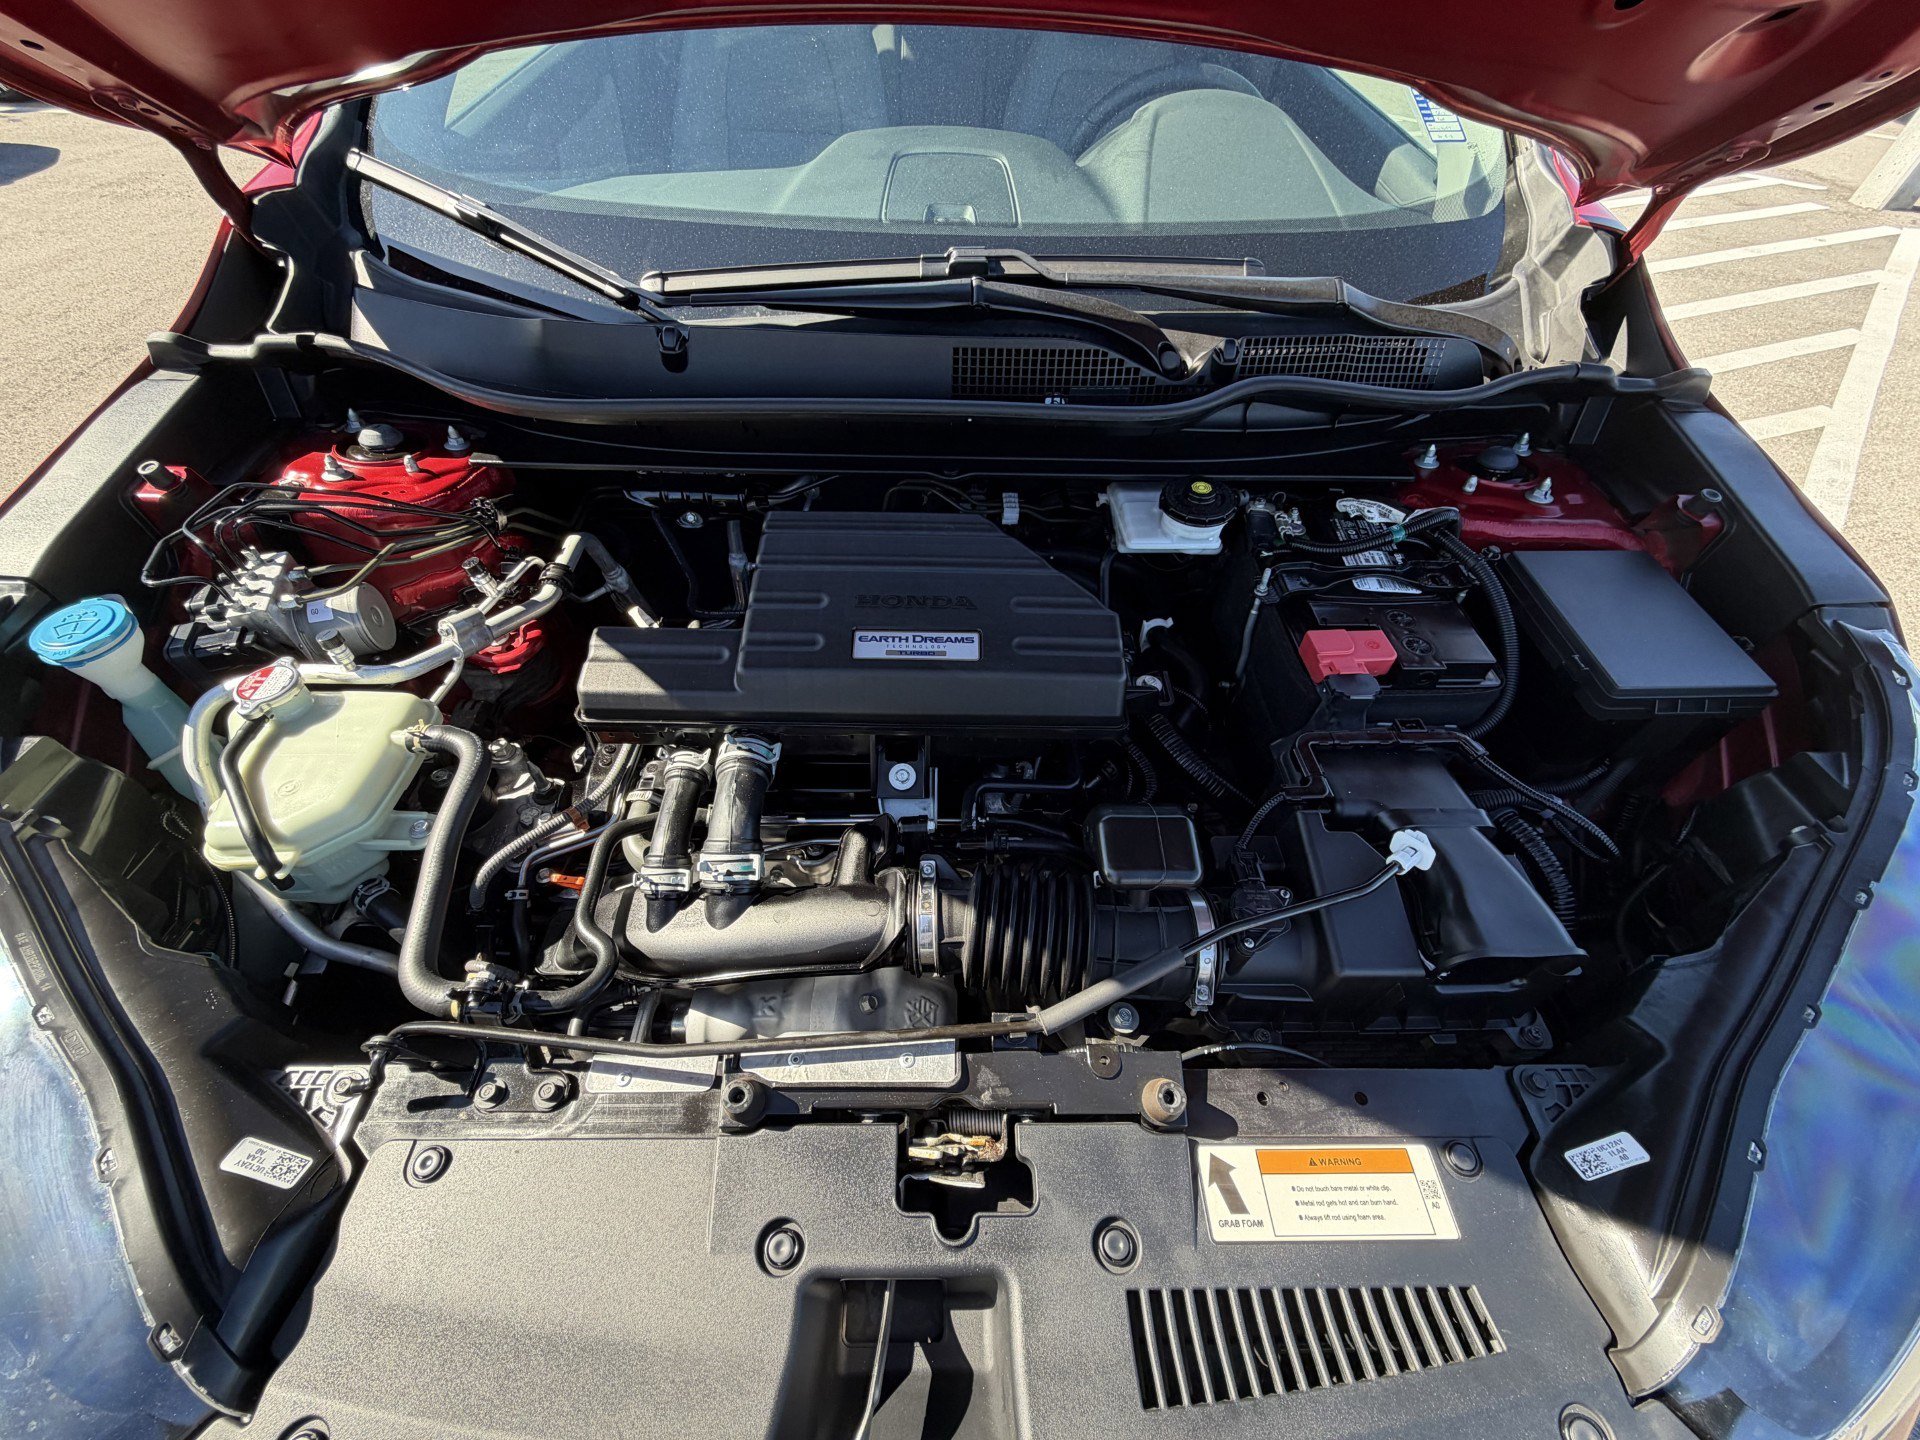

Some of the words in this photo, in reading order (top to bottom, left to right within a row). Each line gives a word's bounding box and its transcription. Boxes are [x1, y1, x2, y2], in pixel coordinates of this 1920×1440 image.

[854, 594, 978, 610] HONDA
[858, 635, 909, 643] EARTH
[1318, 1157, 1362, 1166] WARNING
[1304, 1214, 1323, 1222] Always
[1323, 1213, 1331, 1221] lift
[1331, 1213, 1341, 1221] rod
[1341, 1214, 1357, 1222] using
[1356, 1213, 1371, 1221] foam
[1218, 1219, 1241, 1228] GRAB
[1241, 1219, 1265, 1228] FOAM
